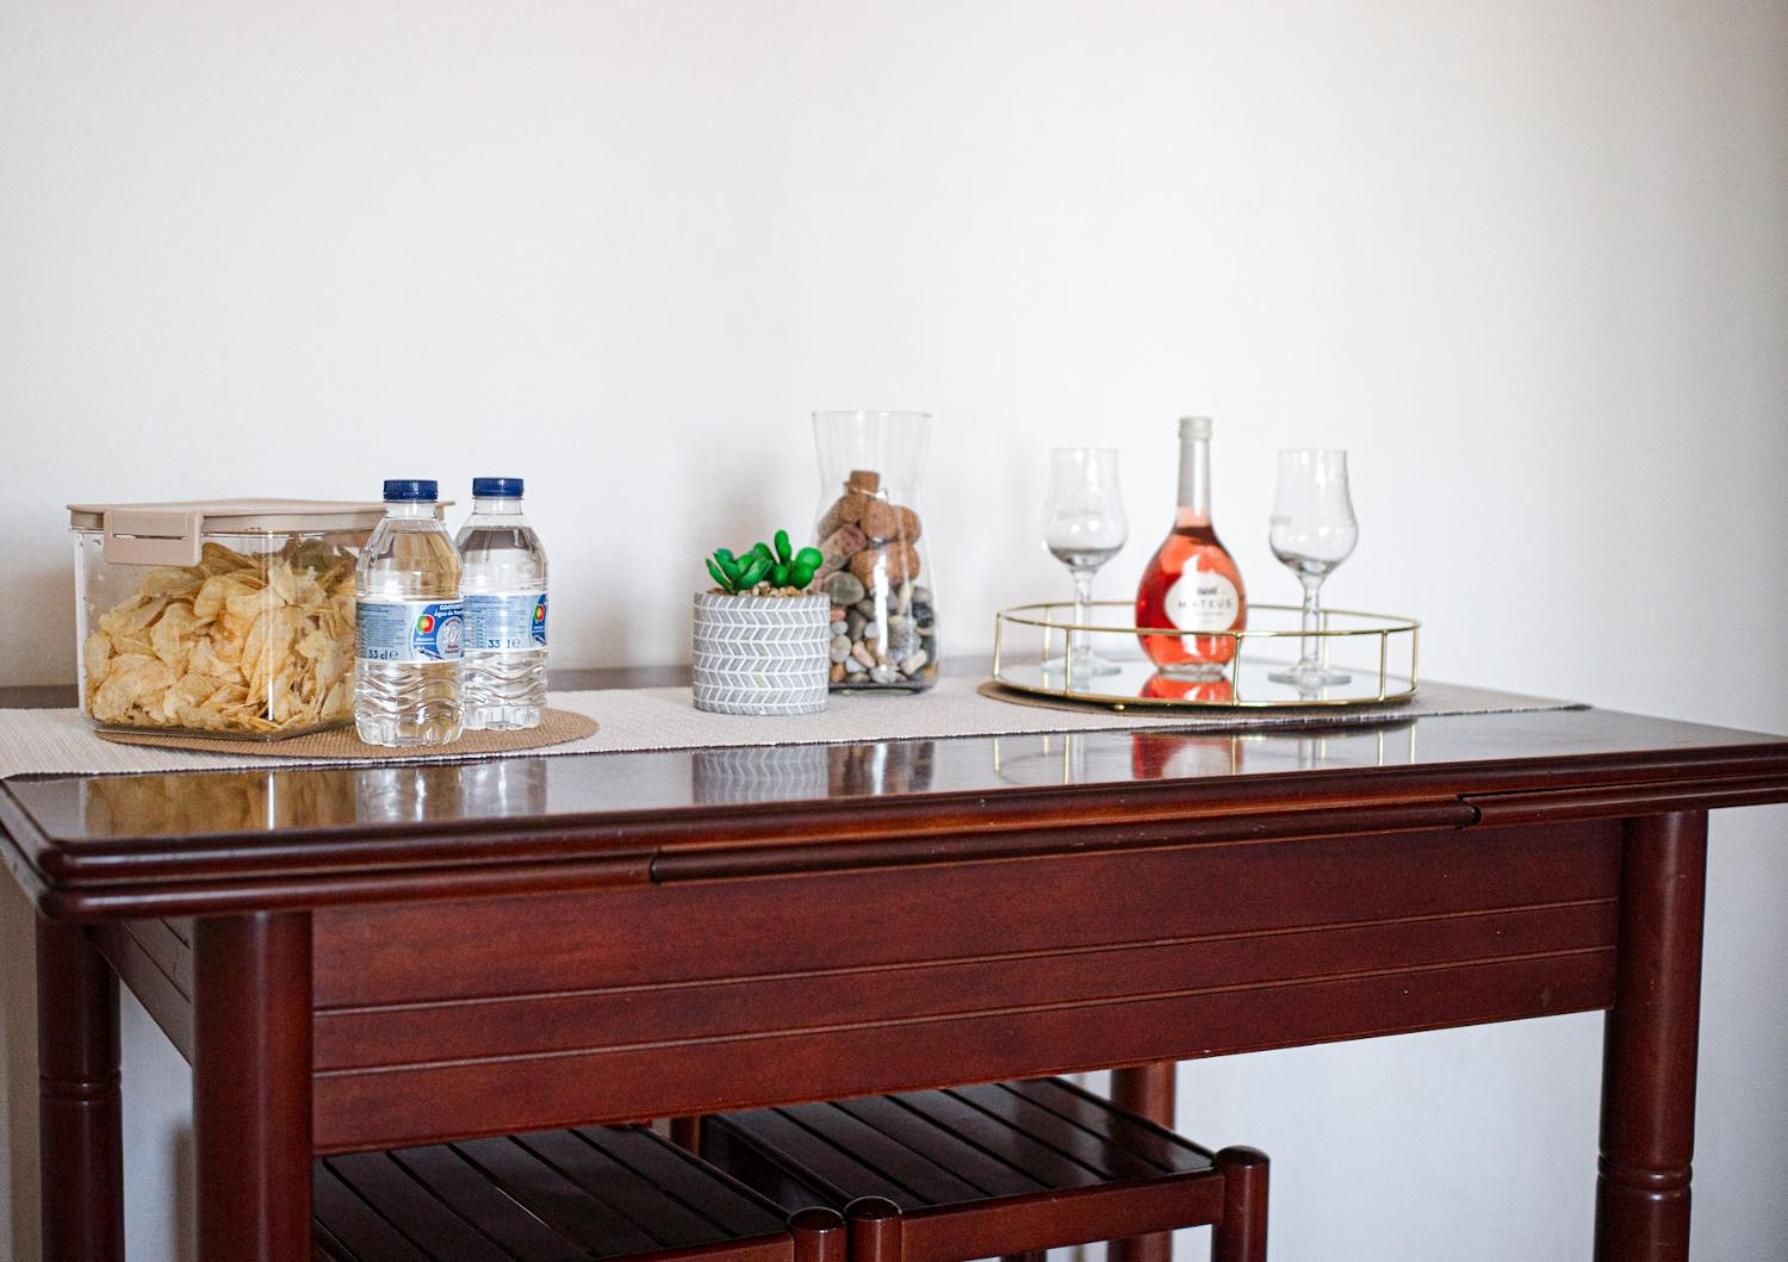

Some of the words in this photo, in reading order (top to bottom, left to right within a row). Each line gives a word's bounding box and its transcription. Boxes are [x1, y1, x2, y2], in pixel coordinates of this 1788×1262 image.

[1178, 599, 1232, 610] MATEUS
[487, 639, 501, 648] 33
[368, 649, 379, 659] 33
